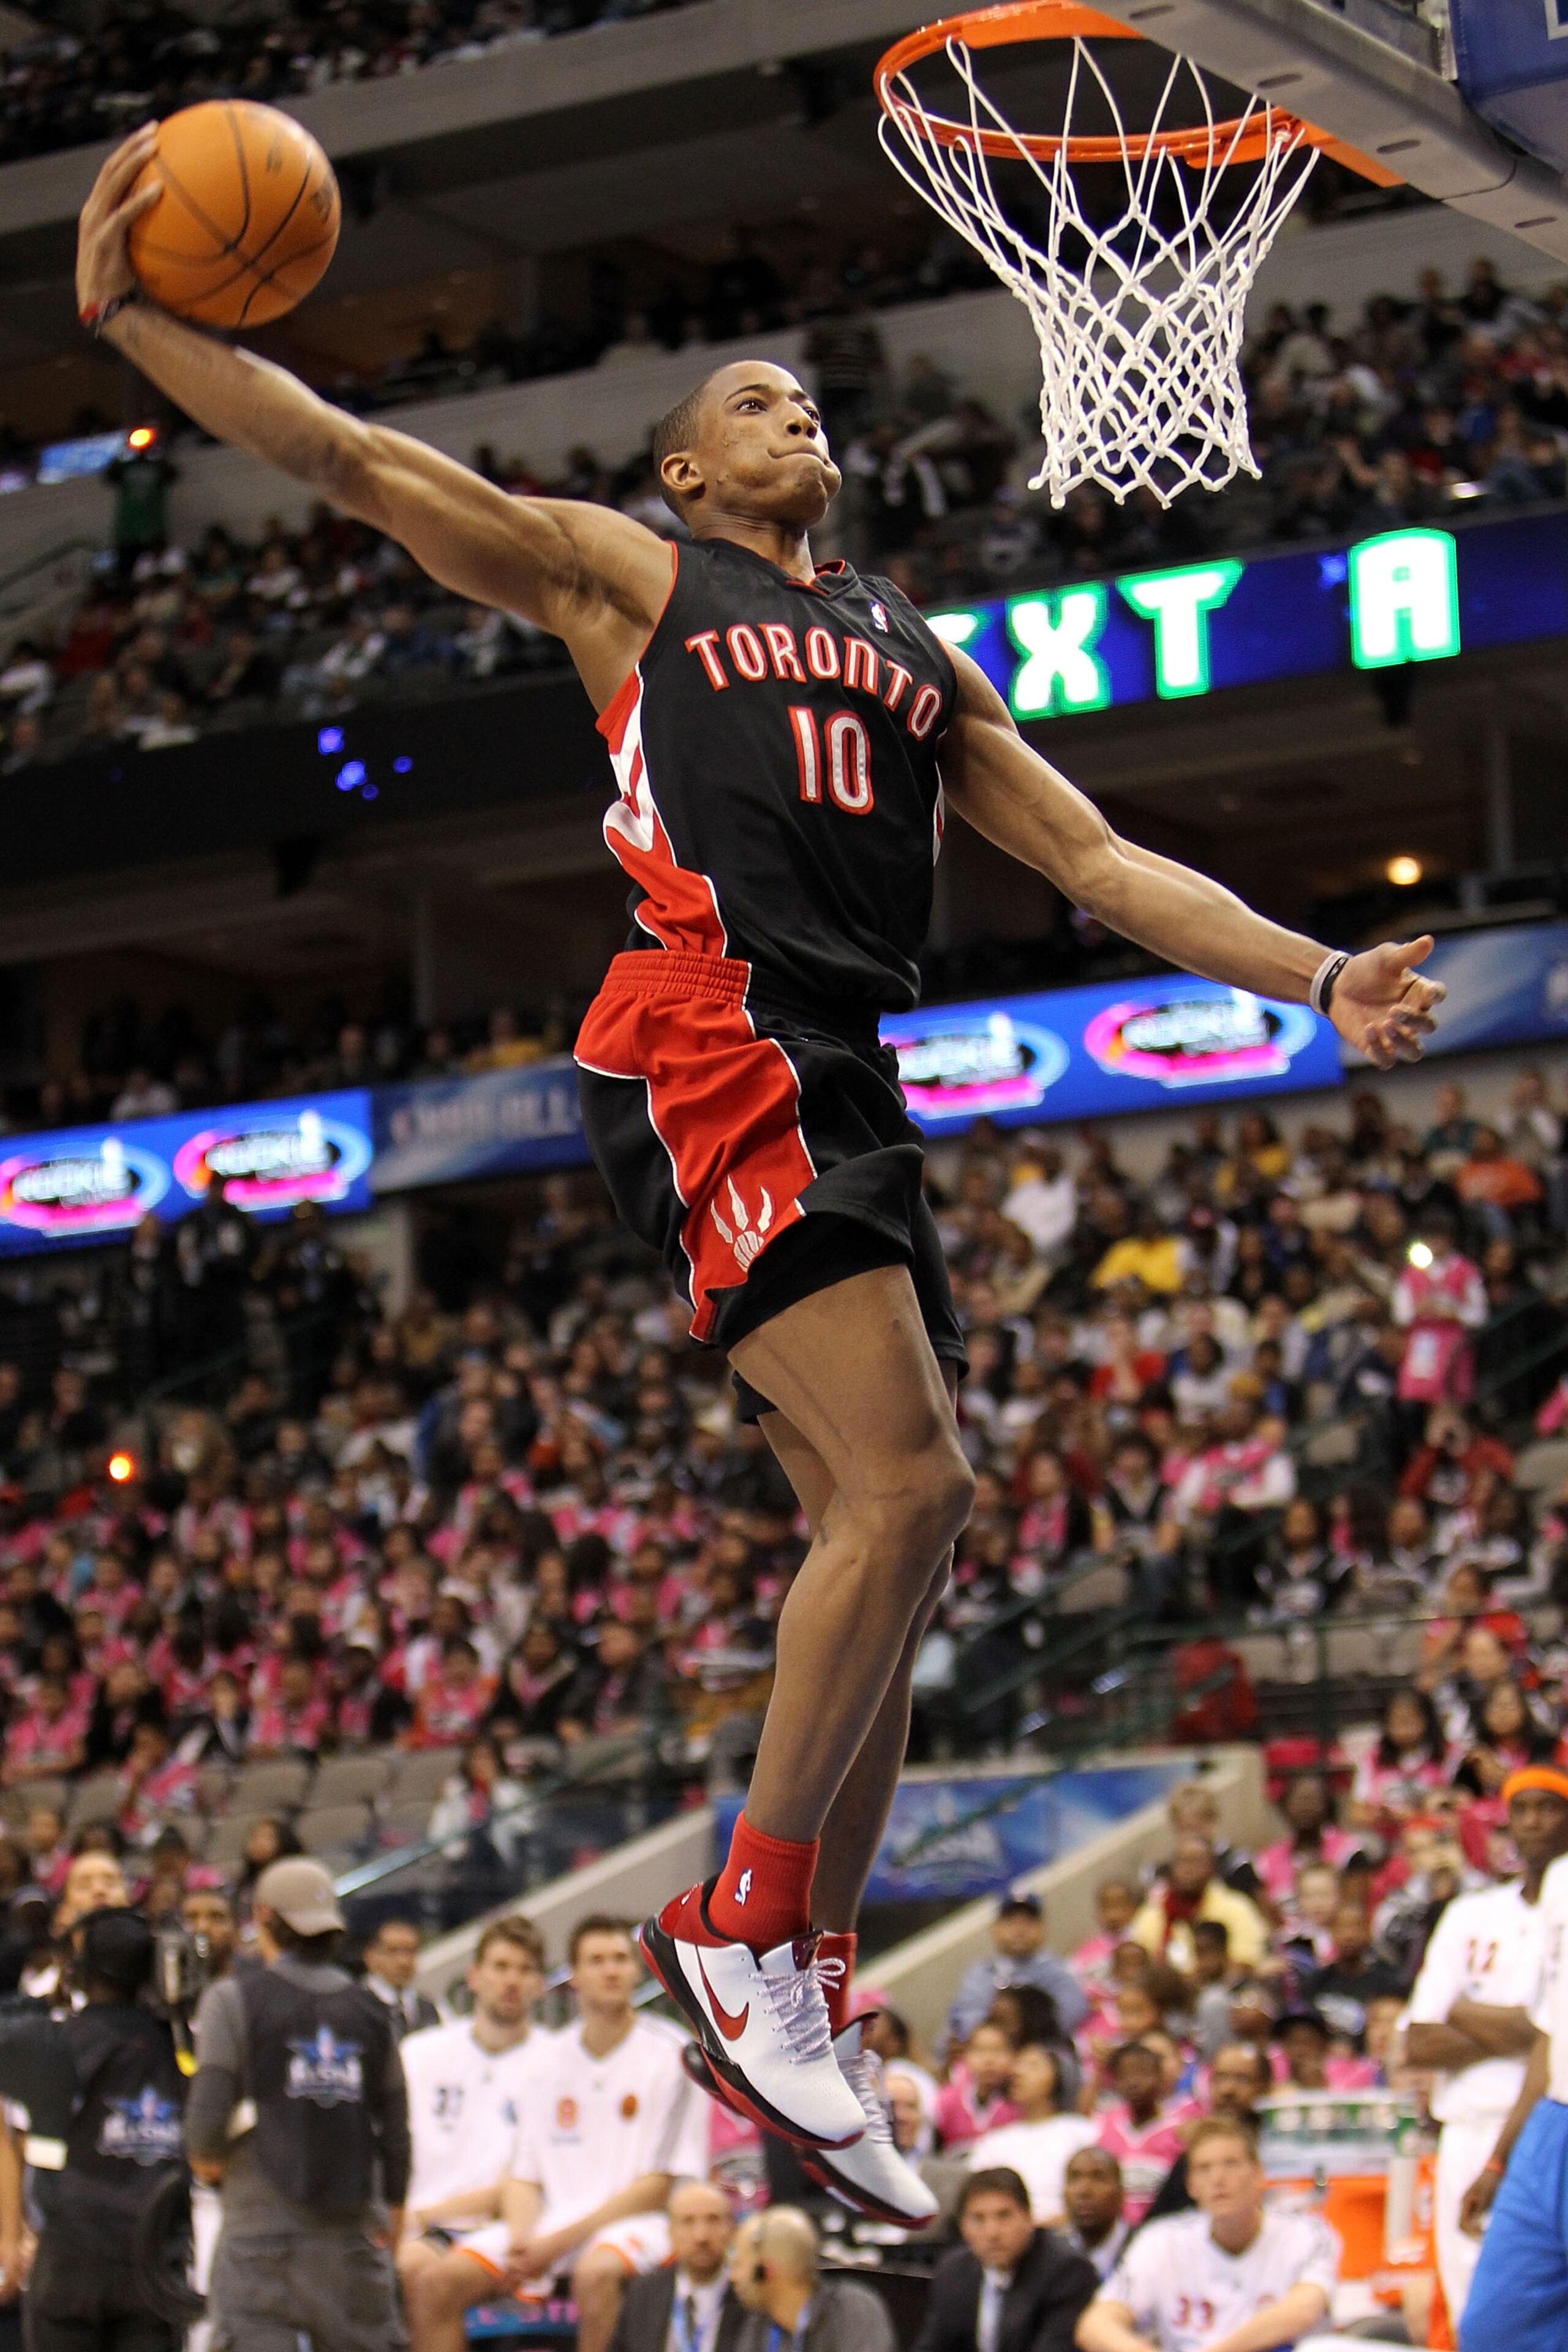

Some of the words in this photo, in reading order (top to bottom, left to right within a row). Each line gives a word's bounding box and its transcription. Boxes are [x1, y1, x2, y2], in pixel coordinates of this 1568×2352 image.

[1349, 527, 1461, 669] A
[685, 623, 943, 741] TORONTO
[788, 705, 874, 816] 10
[1170, 2295, 1216, 2332] 33
